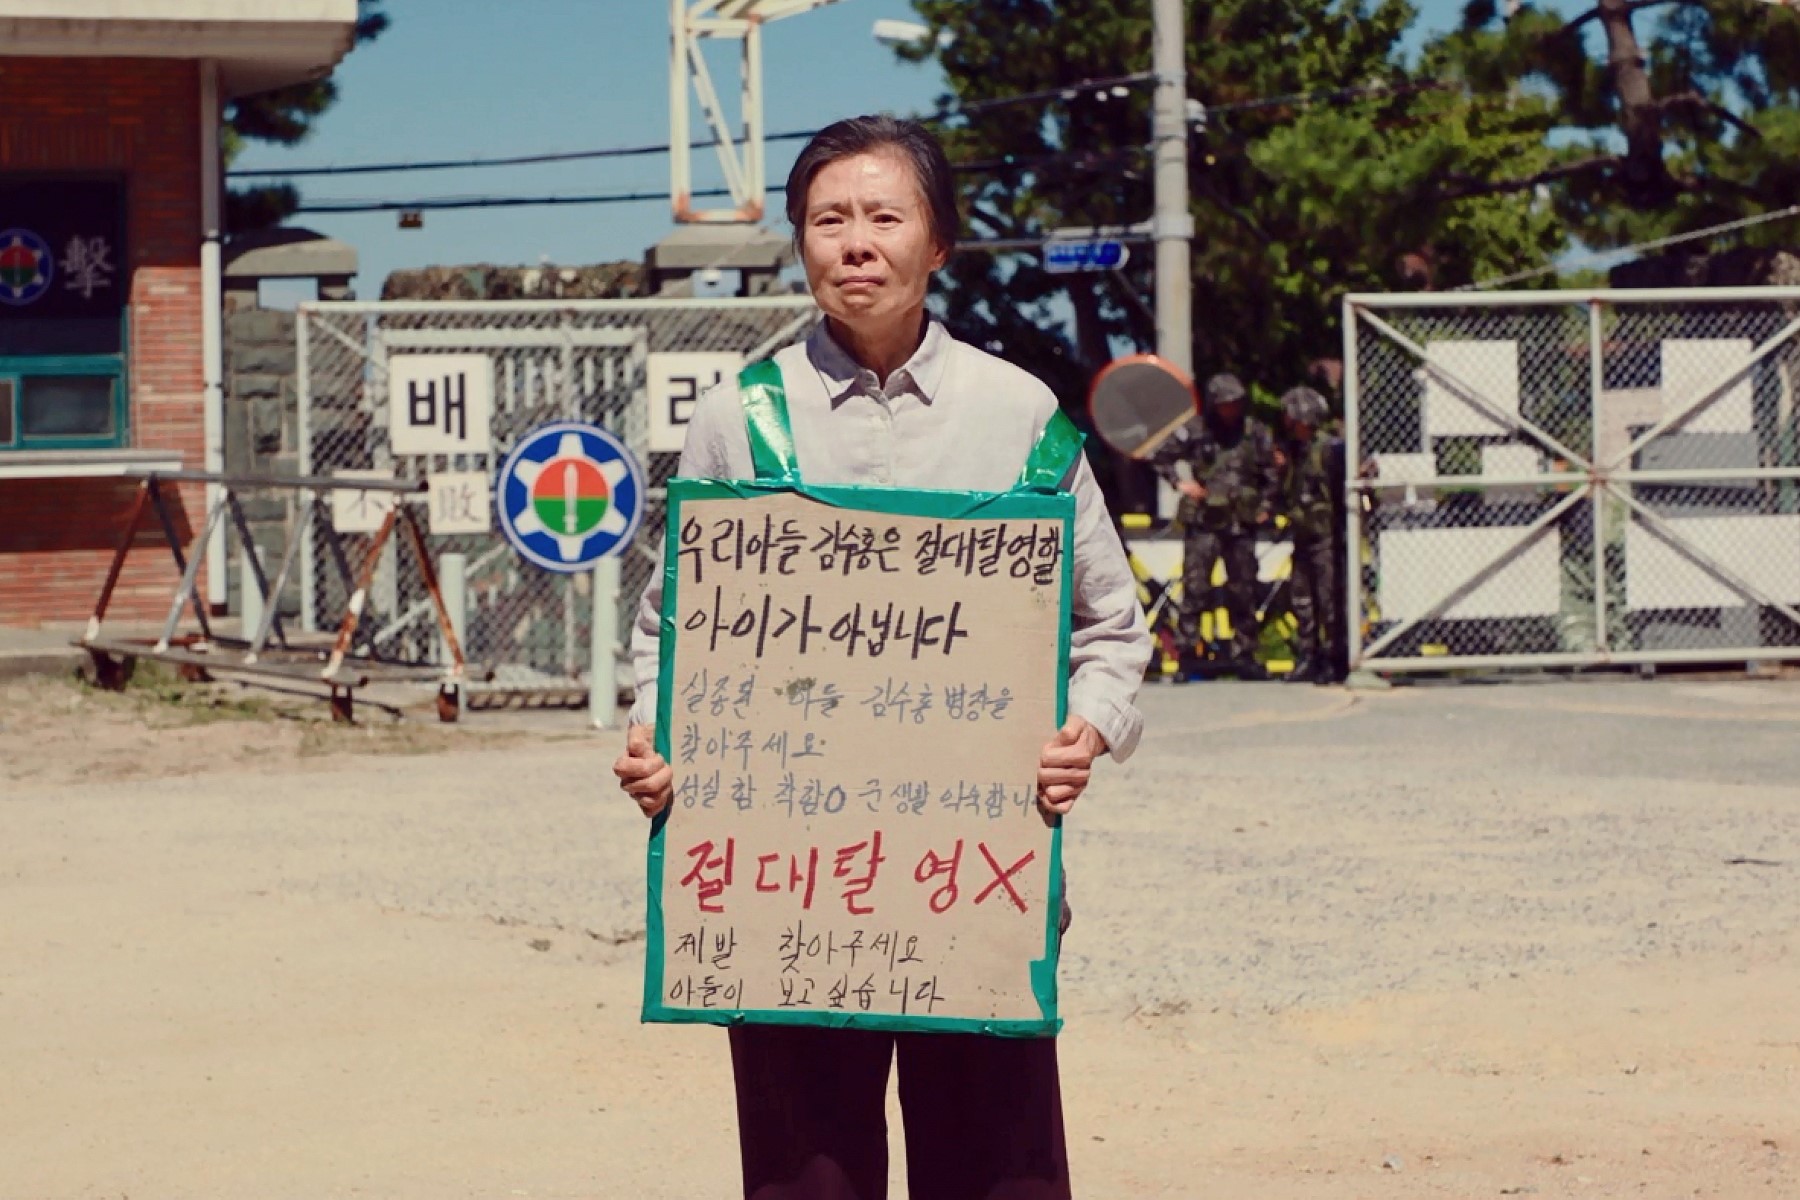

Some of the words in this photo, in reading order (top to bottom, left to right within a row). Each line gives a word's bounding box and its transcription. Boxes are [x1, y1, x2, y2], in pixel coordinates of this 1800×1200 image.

[408, 372, 467, 440] 배
[684, 584, 823, 658] 아이가
[674, 926, 738, 970] 제발
[669, 974, 744, 1010] 아들이
